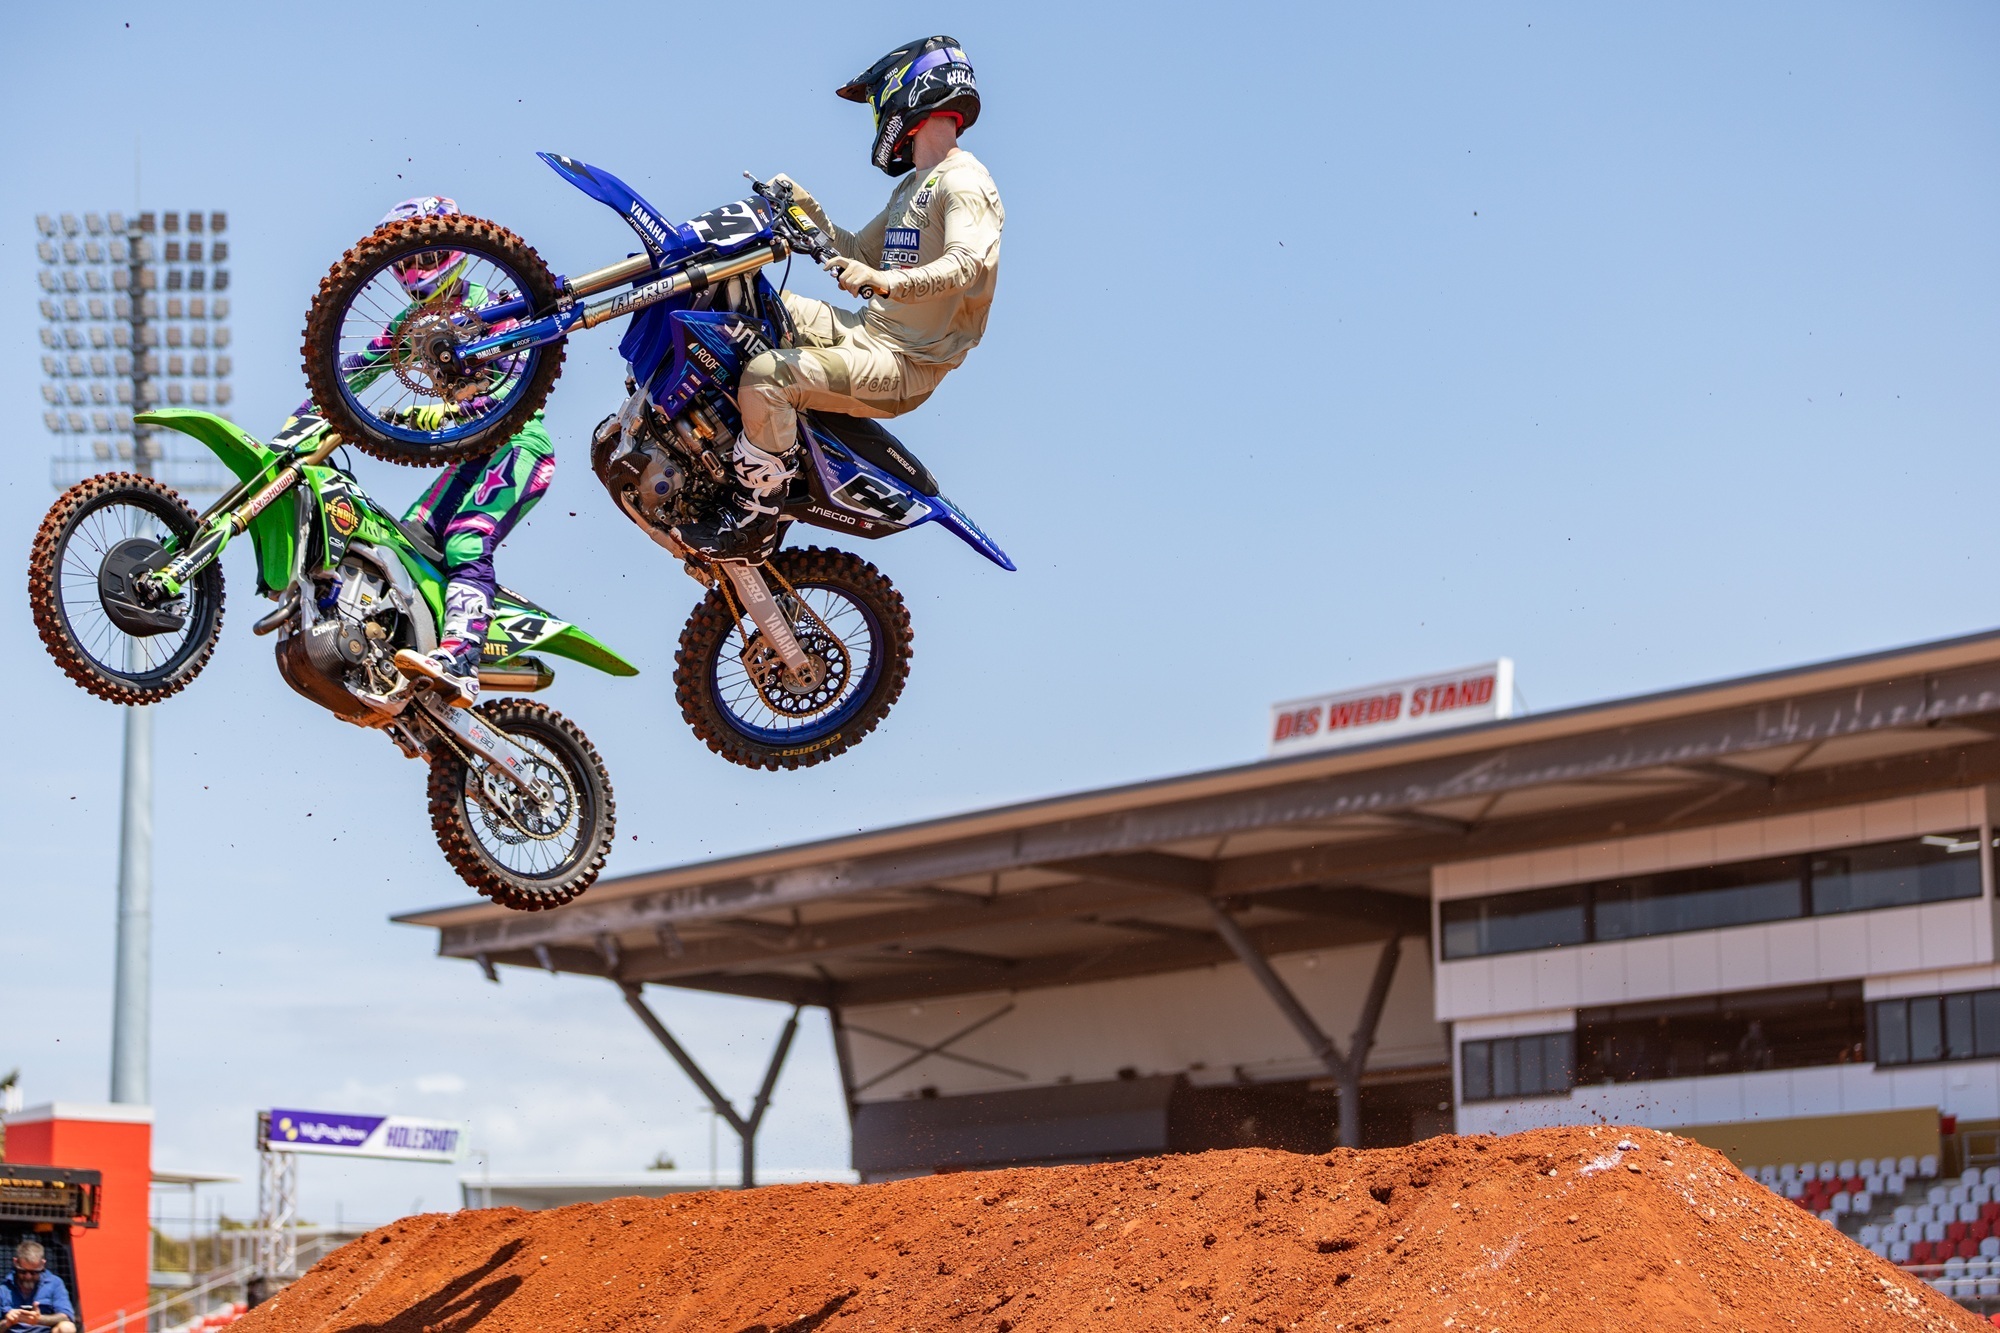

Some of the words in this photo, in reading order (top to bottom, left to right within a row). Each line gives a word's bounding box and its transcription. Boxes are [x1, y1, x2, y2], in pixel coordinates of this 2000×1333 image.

[626, 216, 654, 245] JAECOO
[629, 201, 667, 245] YAMAHA
[888, 231, 918, 247] YAMAHA
[611, 276, 675, 311] APRO
[475, 345, 501, 359] YAMALUBE
[694, 348, 730, 383] ROOFTEK
[263, 473, 295, 507] SHOWA
[325, 502, 359, 529] PENRITE
[807, 505, 856, 526] JAECOO
[950, 512, 981, 541] DUNLOP
[185, 551, 212, 578] DUNLOP
[737, 567, 766, 602] APRO
[507, 616, 545, 641] 4
[763, 611, 800, 661] YAMAHA
[1273, 706, 1322, 742] DES
[1327, 691, 1403, 732] WEBB
[1409, 675, 1495, 718] STAND
[505, 756, 525, 775] MTX
[299, 1121, 369, 1143] MyPayNow
[385, 1126, 459, 1153] HOLESHOT
